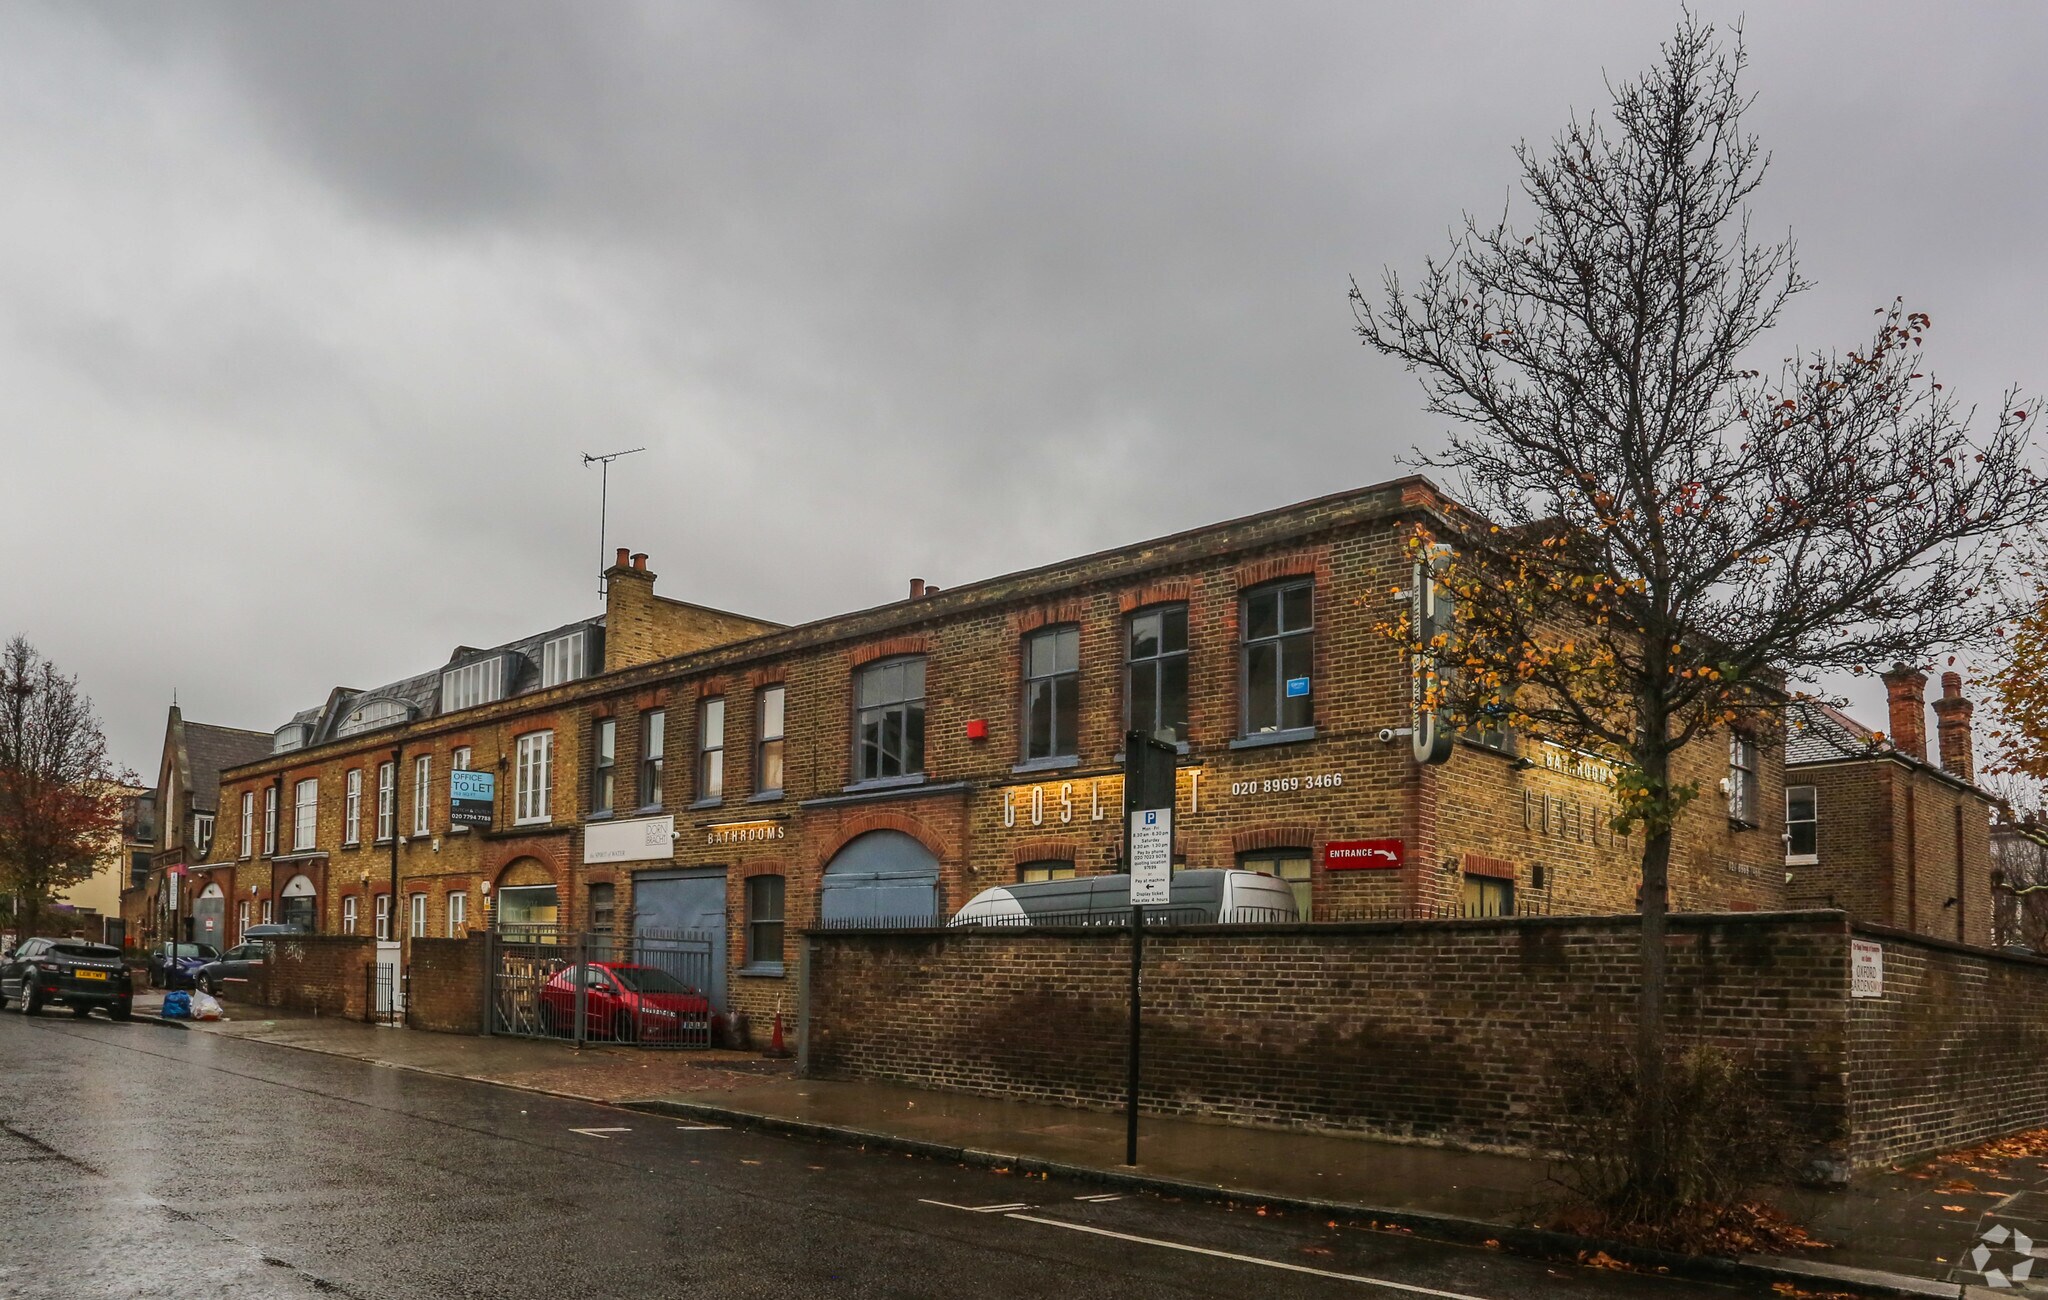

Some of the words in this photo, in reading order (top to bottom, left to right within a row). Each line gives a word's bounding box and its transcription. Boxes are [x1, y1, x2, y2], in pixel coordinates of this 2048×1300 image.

[1546, 752, 1615, 783] BAROOM
[454, 773, 483, 782] OFFICE
[1232, 781, 1257, 796] 020
[1263, 777, 1299, 793] 8969
[1305, 773, 1342, 789] 3466
[453, 781, 469, 791] TO
[473, 783, 492, 793] LET
[1004, 770, 1201, 828] GOSLT
[708, 826, 784, 844] BATHROOMS
[1330, 848, 1372, 858] ENTRANCE
[1856, 965, 1876, 979] OXFORD
[1851, 979, 1874, 992] ARDENS
